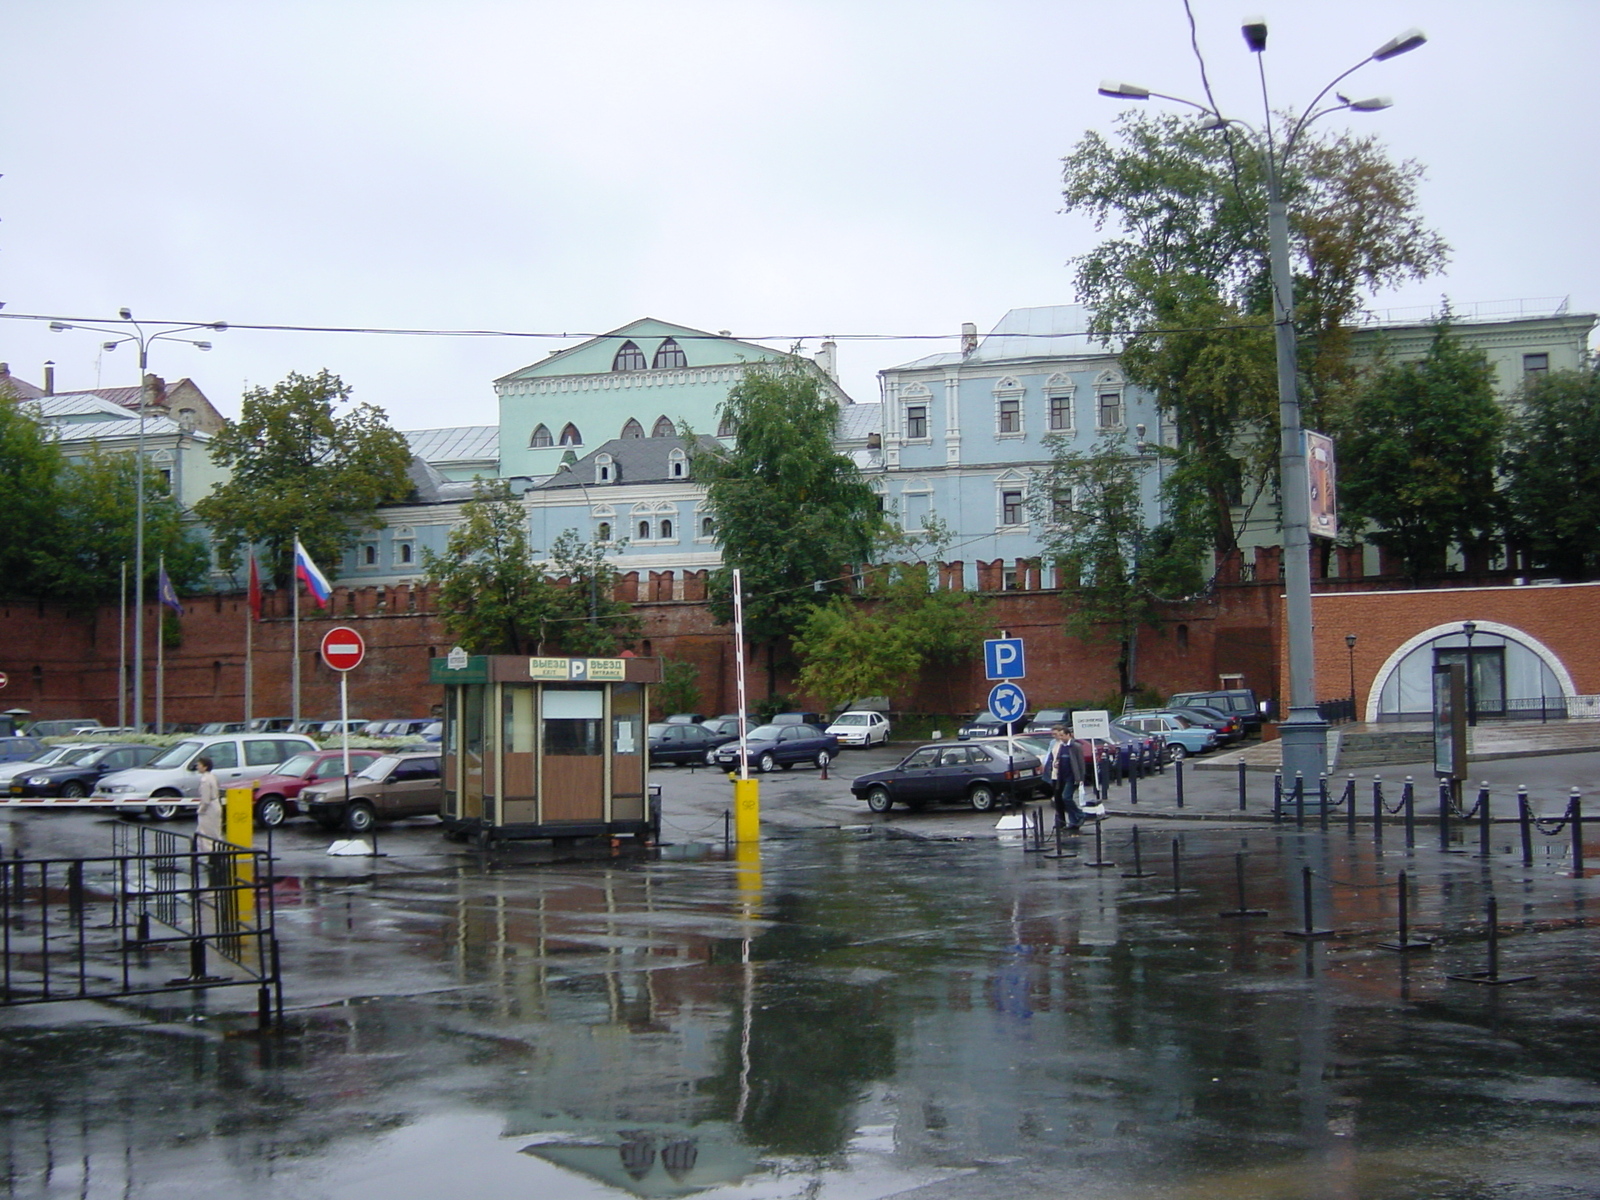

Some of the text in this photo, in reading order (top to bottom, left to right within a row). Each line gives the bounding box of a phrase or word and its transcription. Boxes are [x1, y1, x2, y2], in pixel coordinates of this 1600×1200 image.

[532, 659, 567, 669] ВЫЕЗД
[995, 643, 1017, 675] P
[571, 660, 585, 678] P
